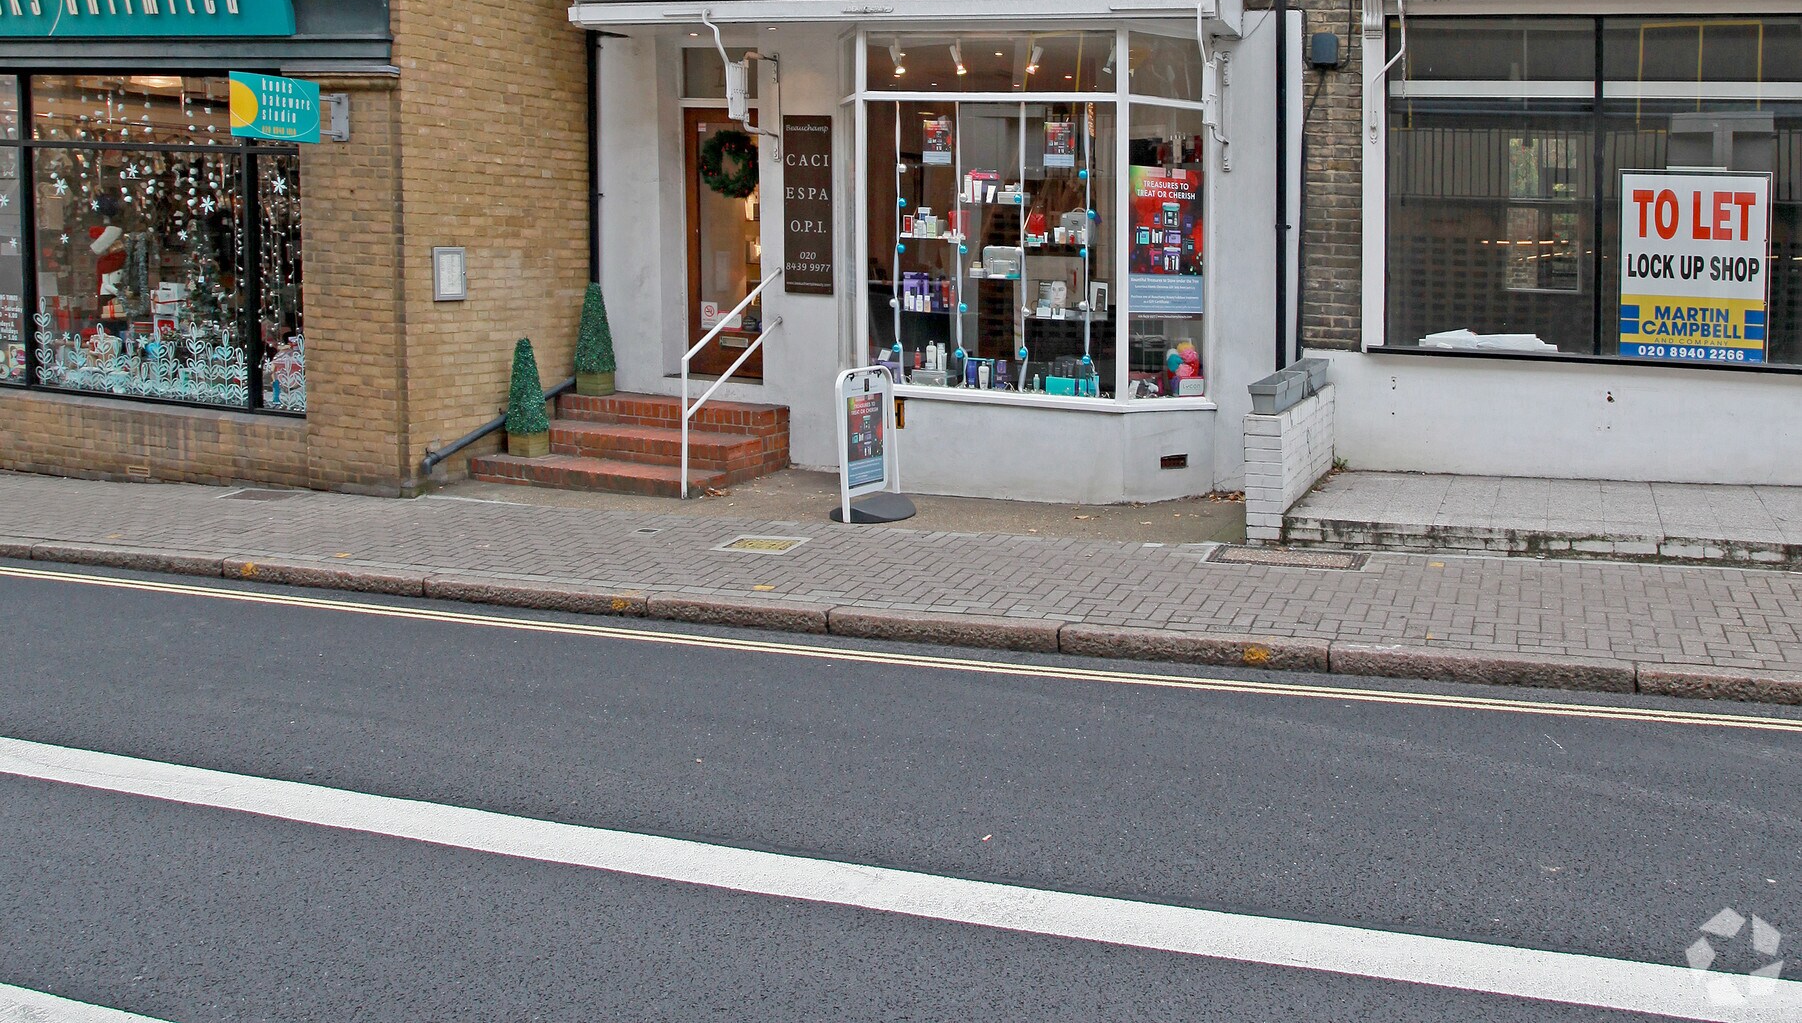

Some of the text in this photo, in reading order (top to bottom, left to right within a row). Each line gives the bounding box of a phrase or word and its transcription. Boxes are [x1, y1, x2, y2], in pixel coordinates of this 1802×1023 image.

[262, 78, 292, 94] kooks
[262, 93, 310, 111] bakeware
[262, 108, 296, 123] studio
[786, 124, 828, 133] Beauchamp
[786, 153, 829, 167] CACI
[1143, 180, 1189, 191] TREASURES TO
[786, 186, 829, 200] ESPA
[1137, 189, 1155, 197] TREAT
[1168, 191, 1196, 200] CHERISH
[1633, 189, 1756, 241] TO LET
[790, 219, 827, 233] O.P.I.
[800, 251, 816, 260] 020
[786, 262, 831, 272] 8439 9977
[1627, 253, 1759, 282] LOCK UP SHOP
[1655, 306, 1729, 324] MARTIN
[1642, 320, 1741, 339] CAMPBELL
[1679, 338, 1729, 346] COMPANY
[1638, 345, 1744, 360] 020 8940 2266
